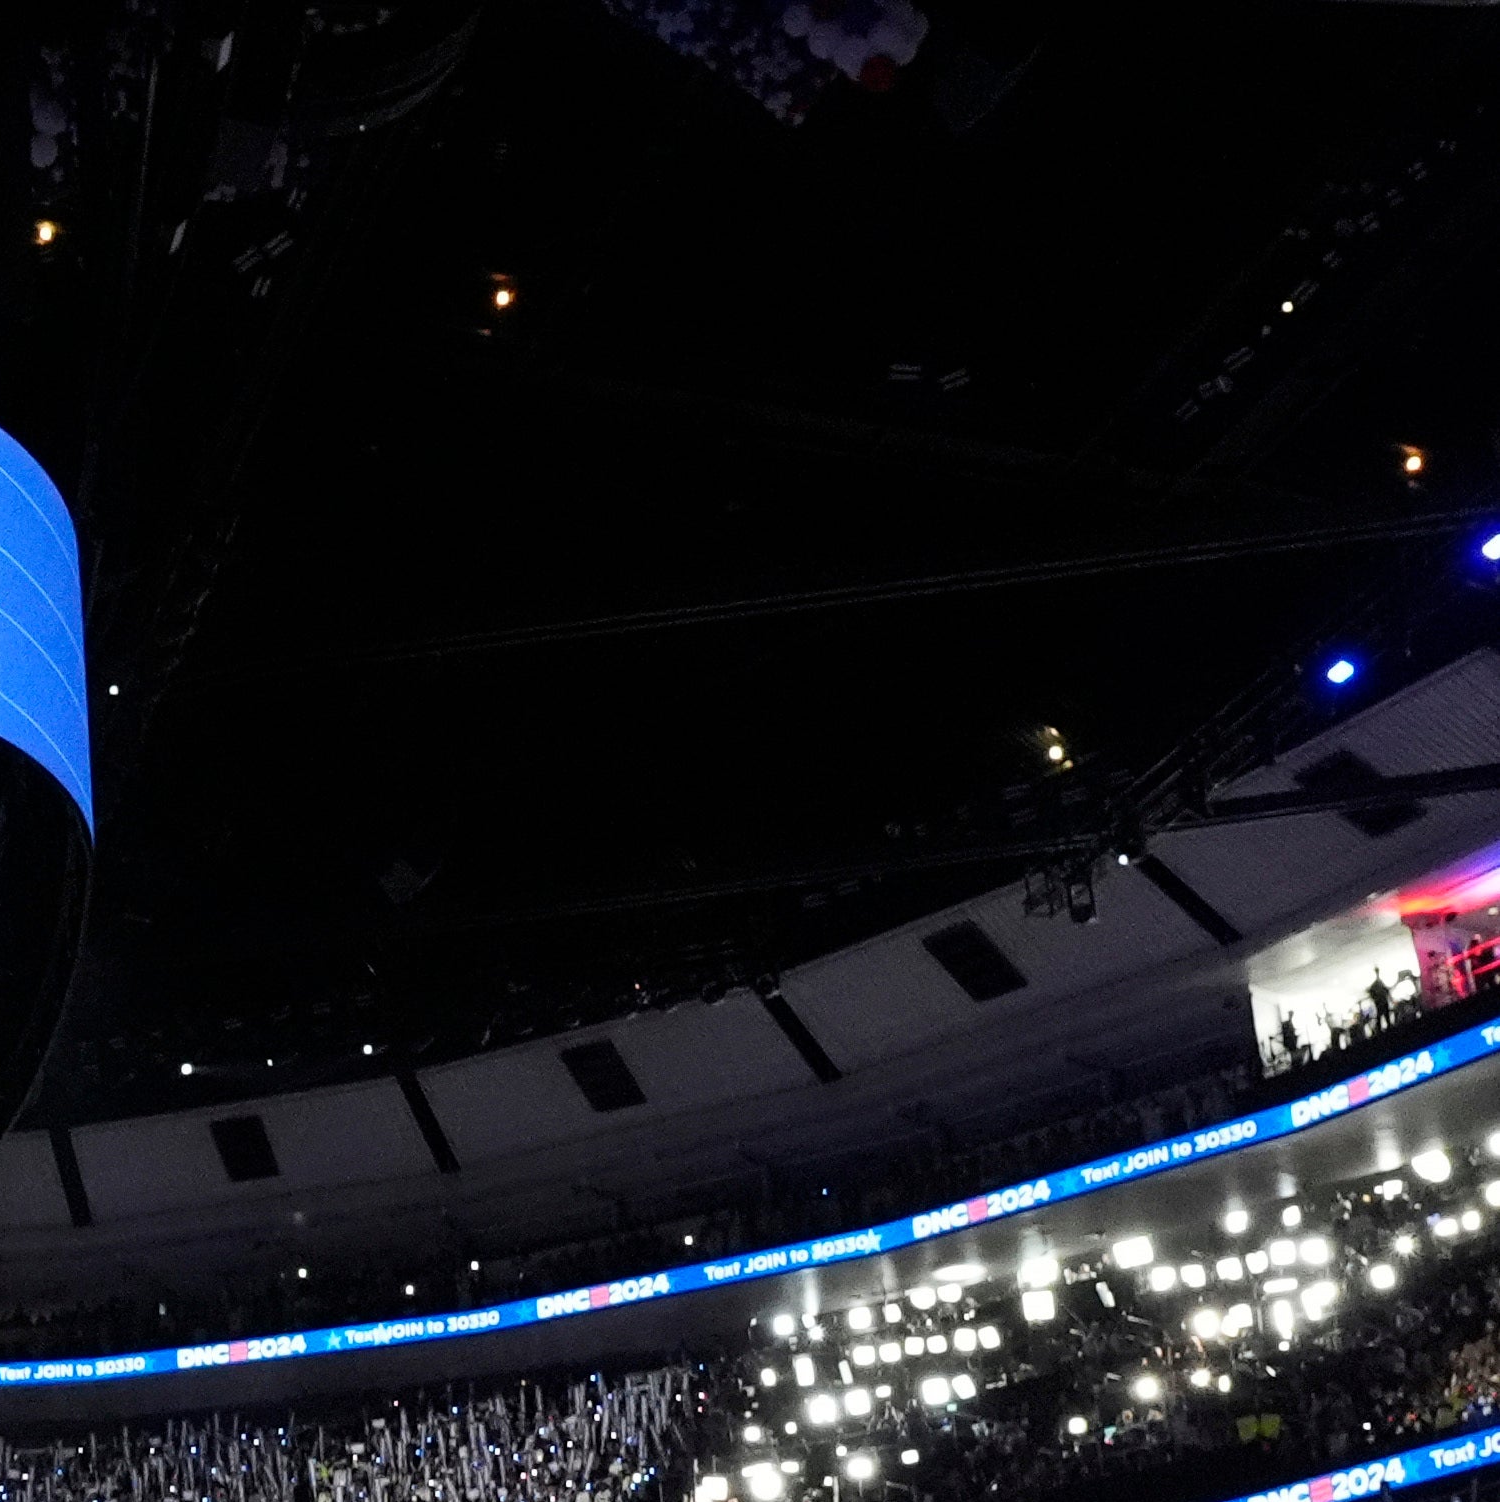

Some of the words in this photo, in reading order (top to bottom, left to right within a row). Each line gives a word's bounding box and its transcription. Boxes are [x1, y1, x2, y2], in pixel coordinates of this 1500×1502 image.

[1291, 1084, 1351, 1127] DNC
[1366, 1051, 1434, 1099] 2024
[1081, 1161, 1120, 1184] Text
[1122, 1146, 1169, 1174] JOIN
[1171, 1142, 1193, 1158] to
[912, 1203, 969, 1239] DNC
[986, 1179, 1052, 1218] 2024
[704, 1261, 741, 1280] Text
[744, 1251, 788, 1274] JOIN
[789, 1249, 811, 1265] to
[536, 1289, 591, 1319] DNC
[607, 1273, 670, 1305] 2024
[33, 1364, 74, 1379] JOIN
[75, 1364, 94, 1377] to
[176, 1343, 230, 1369] DNC
[246, 1334, 307, 1360] 2024
